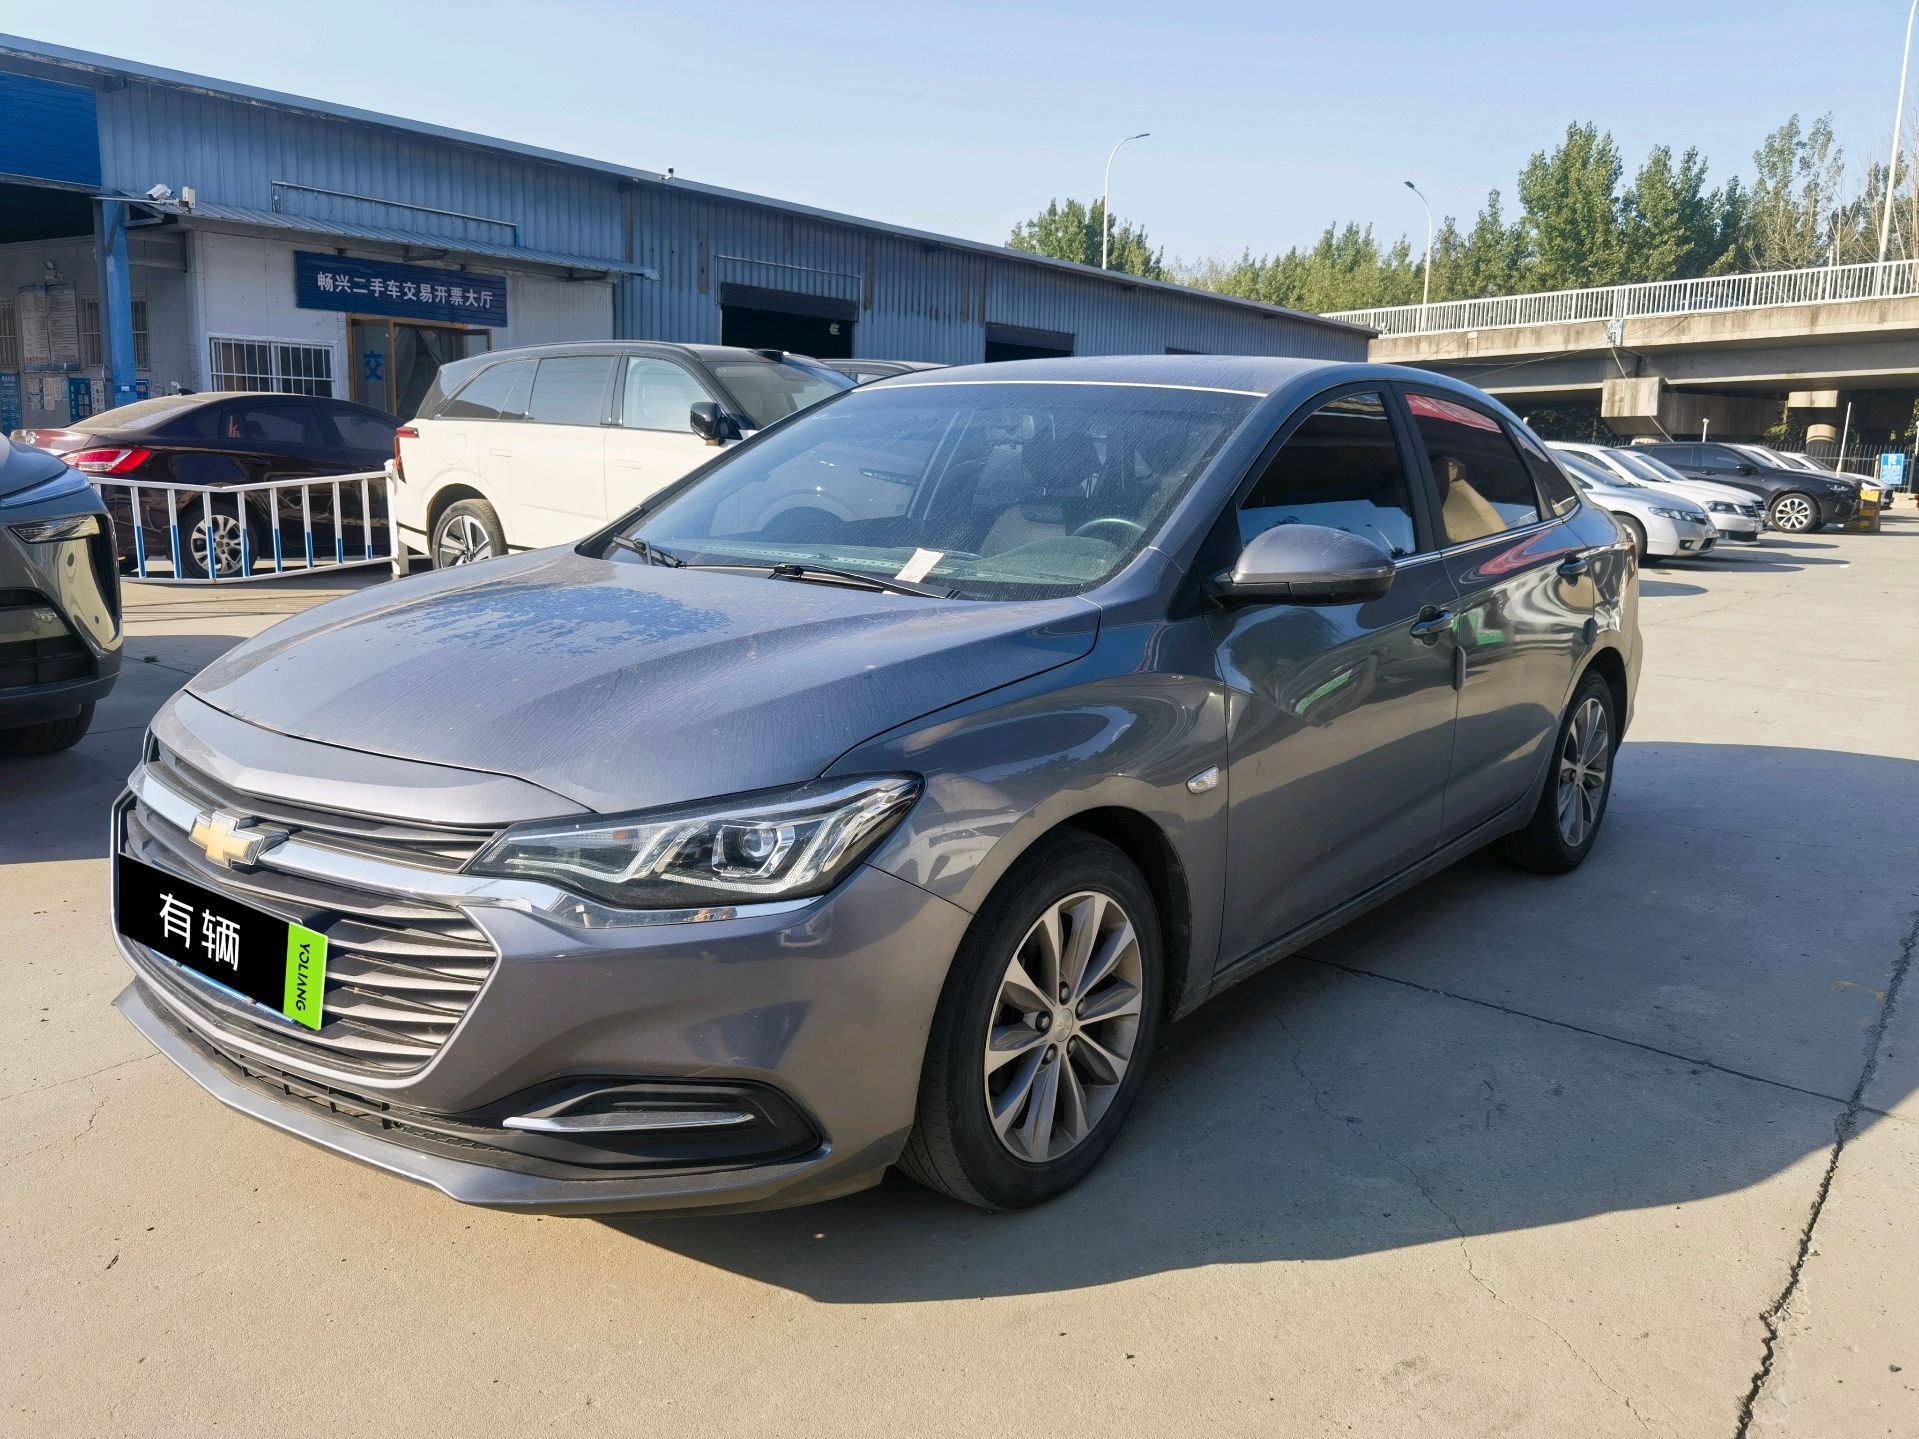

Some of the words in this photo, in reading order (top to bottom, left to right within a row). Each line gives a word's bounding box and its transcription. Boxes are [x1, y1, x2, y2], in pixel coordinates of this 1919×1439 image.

[317, 271, 493, 309] 畅兴二手车交易开票大厅
[363, 351, 383, 381] 交
